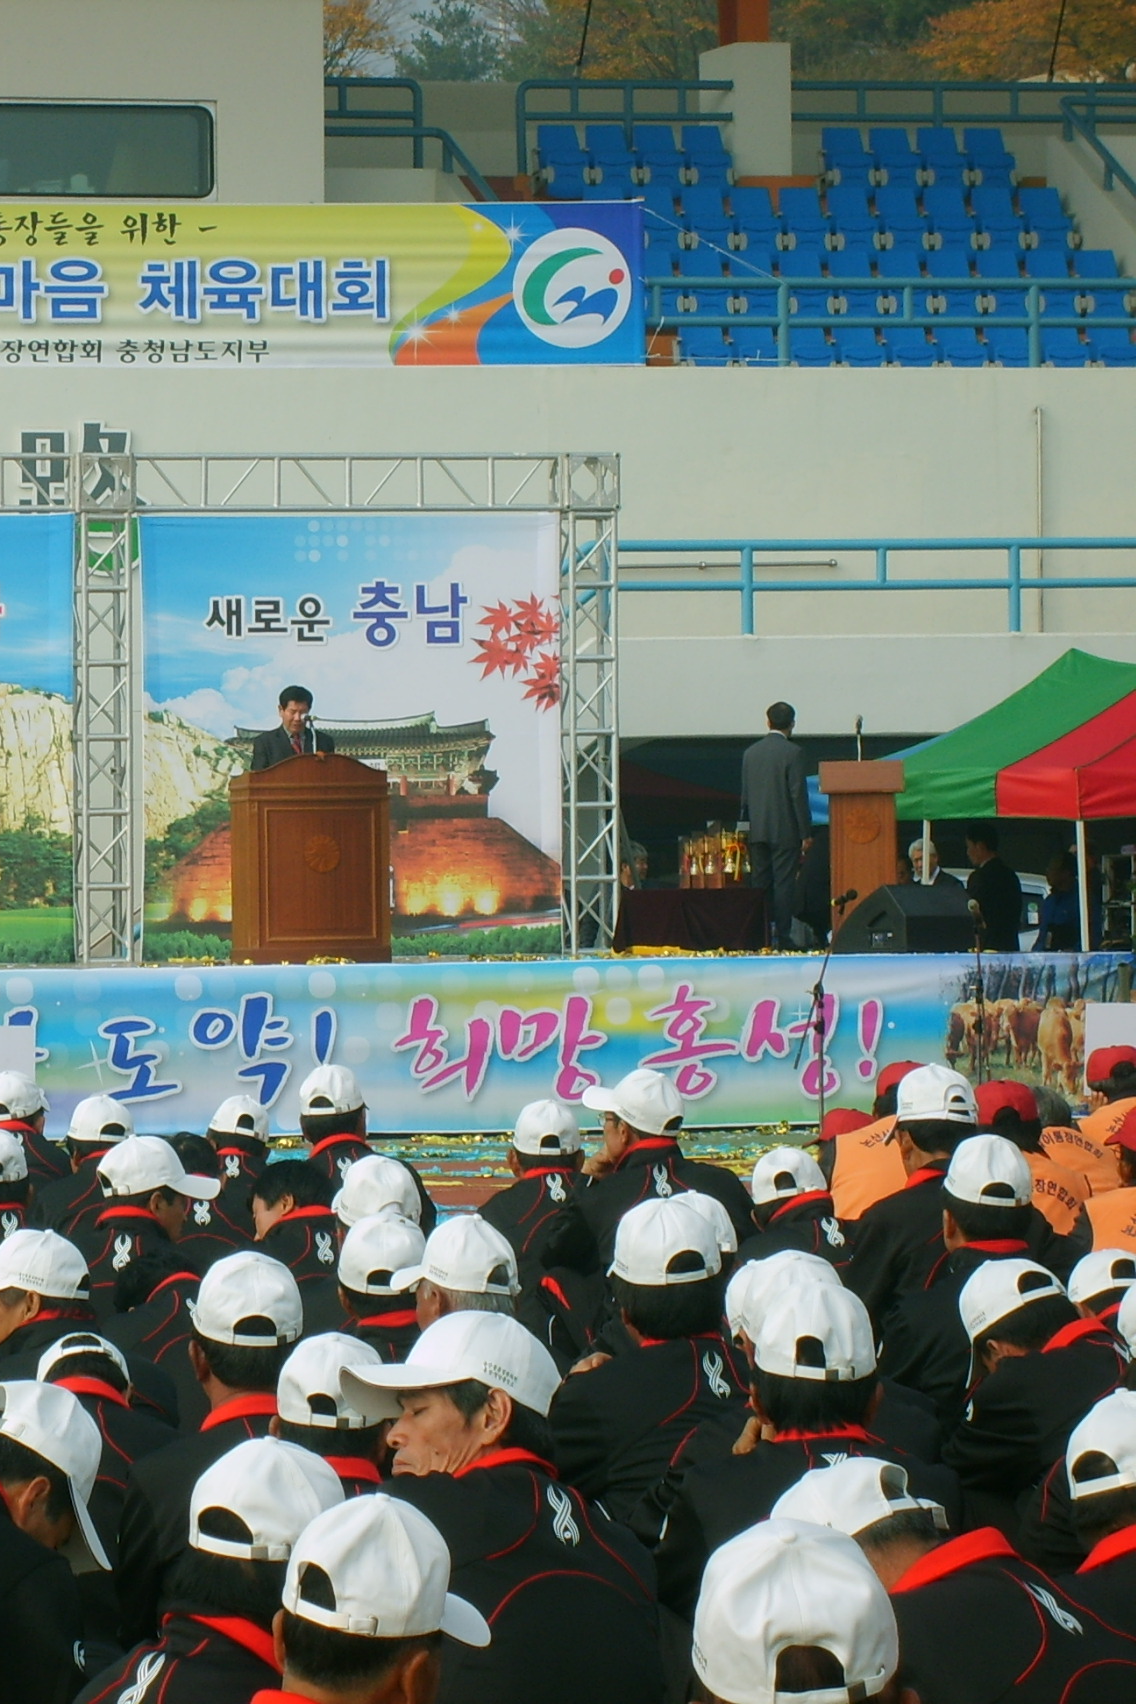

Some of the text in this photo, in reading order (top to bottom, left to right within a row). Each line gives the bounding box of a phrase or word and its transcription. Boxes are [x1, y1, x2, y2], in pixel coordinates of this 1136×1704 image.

[121, 211, 183, 245] 위한
[139, 256, 390, 324] 체육대회
[115, 339, 270, 363] 충청남도지부
[204, 578, 470, 649] 새로운 충남
[396, 992, 602, 1104] 희망
[644, 980, 883, 1100] 홍성!
[1032, 1178, 1077, 1210] 장연합회
